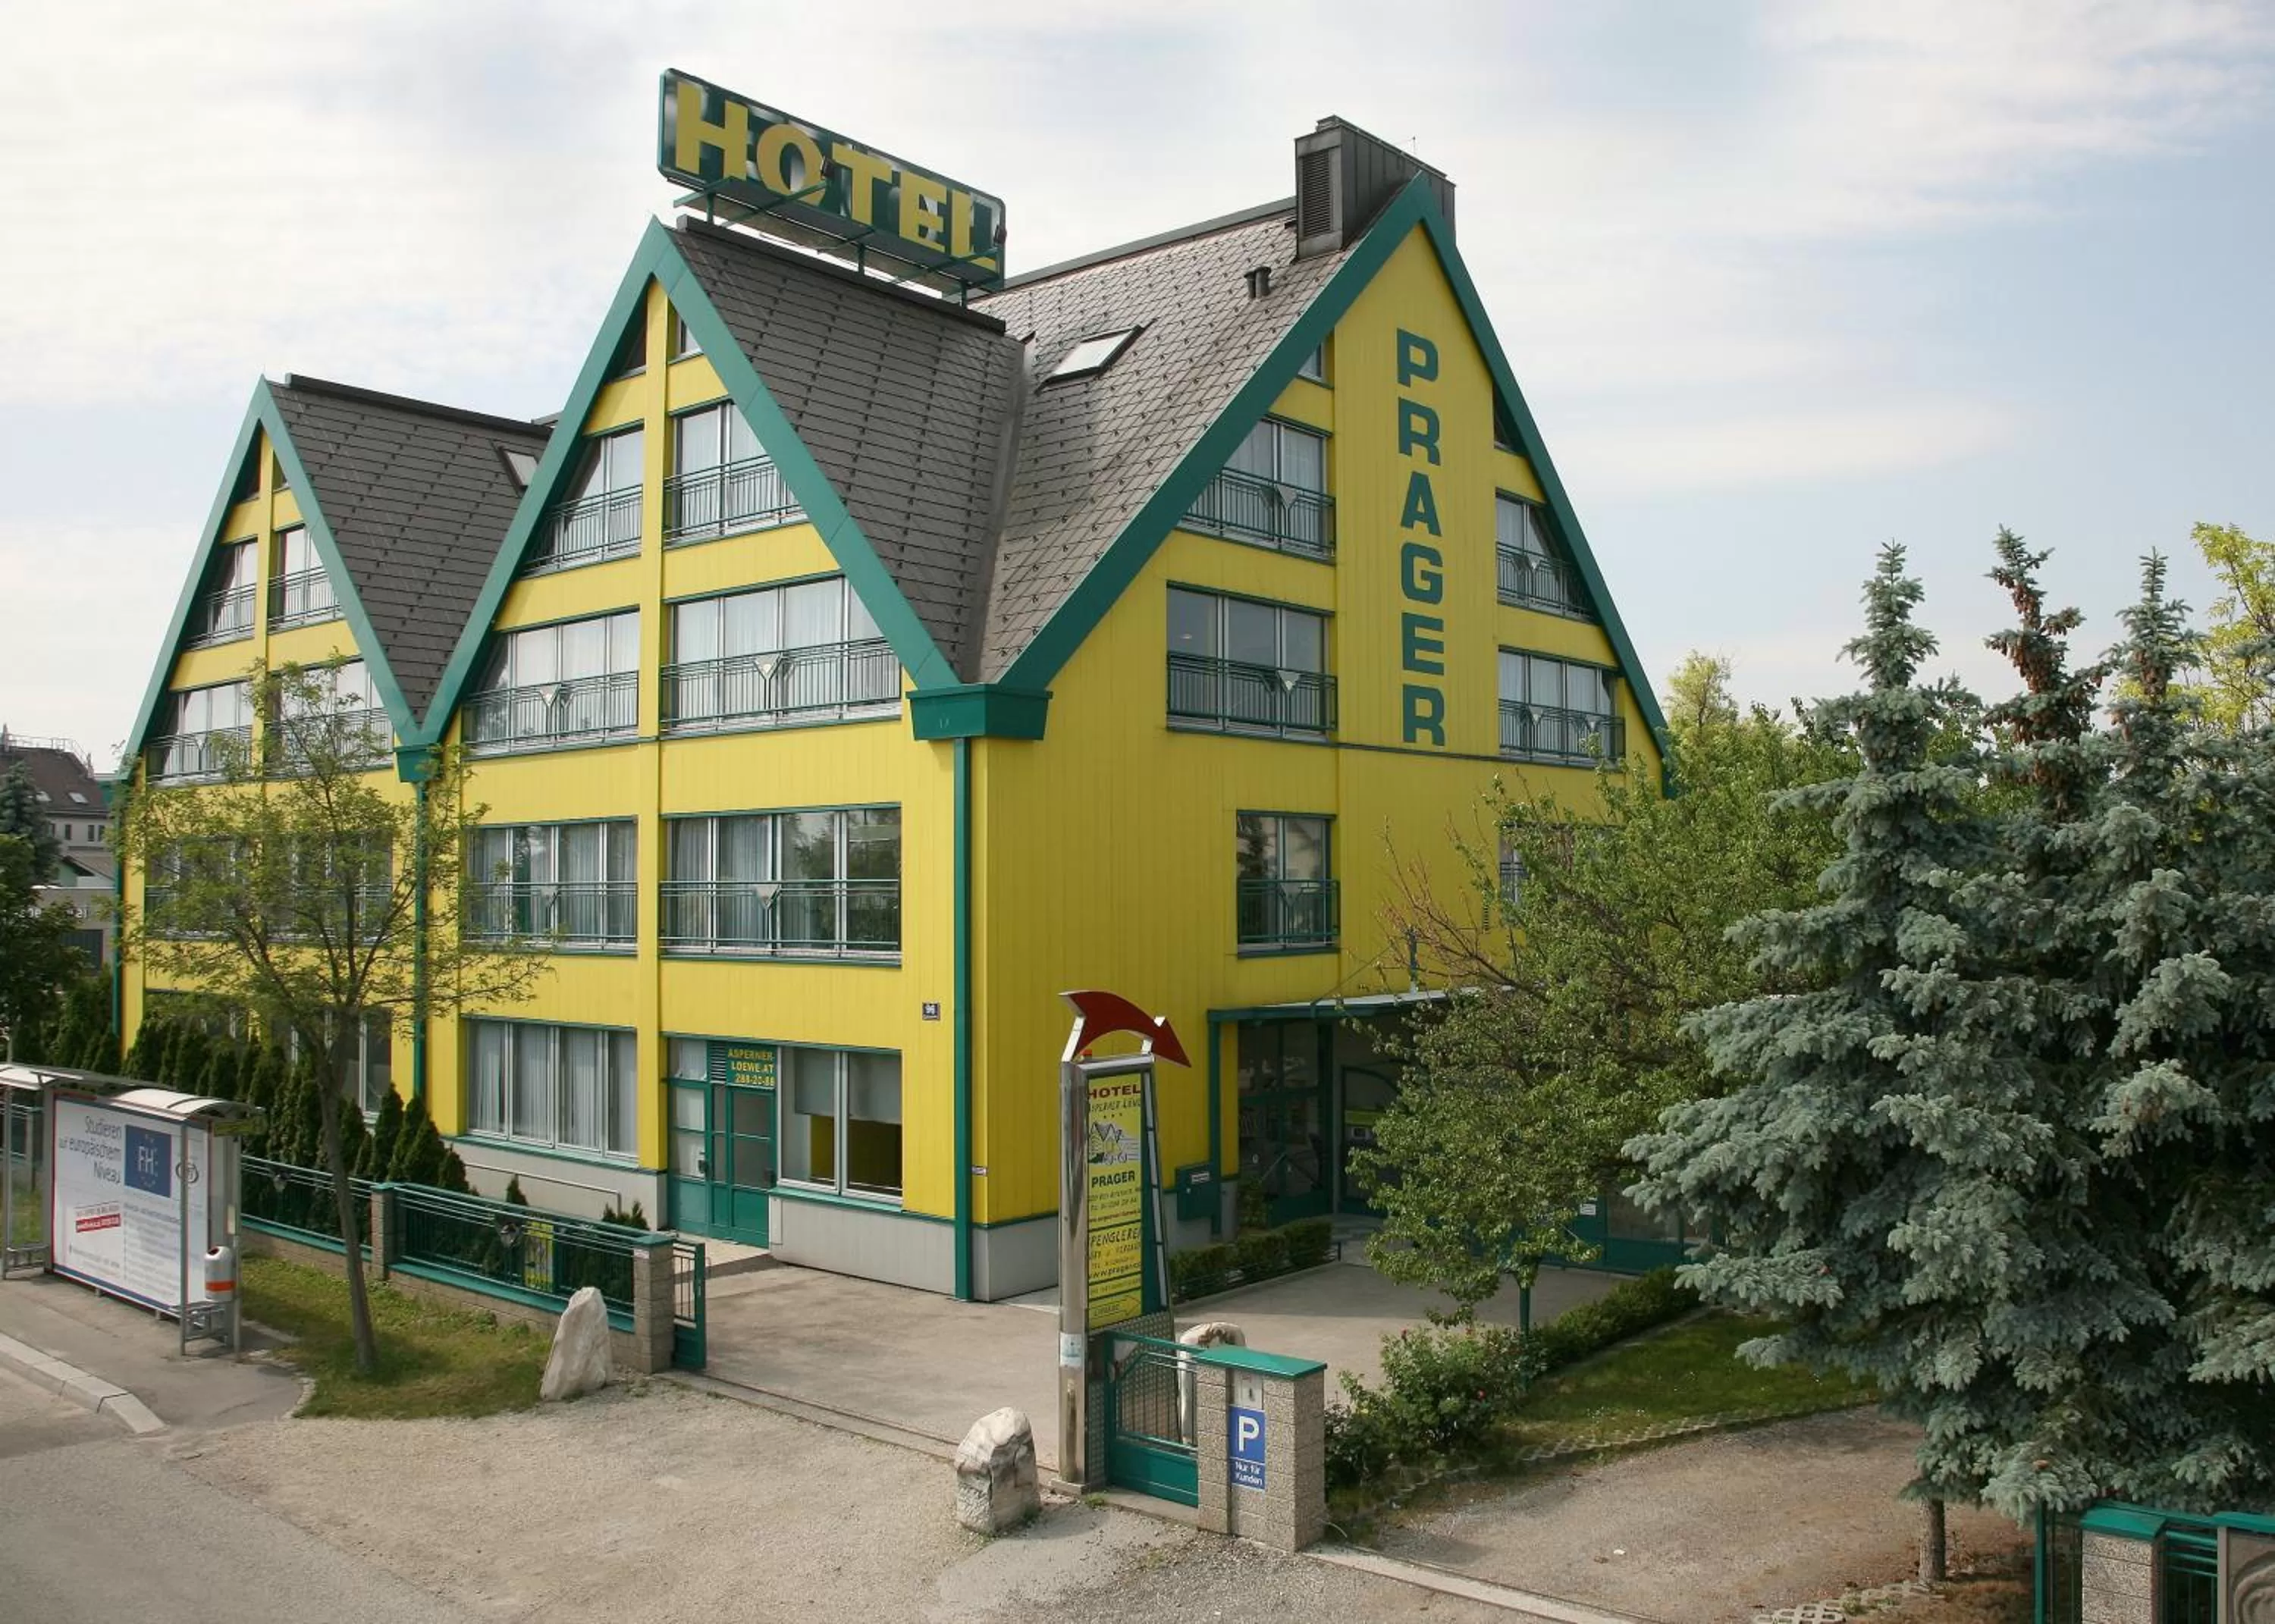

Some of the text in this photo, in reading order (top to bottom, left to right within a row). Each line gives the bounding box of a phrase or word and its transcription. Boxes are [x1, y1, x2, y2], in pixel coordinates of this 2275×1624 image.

[676, 81, 998, 279] HOTEL
[1396, 328, 1445, 747] PRAGER
[1089, 1083, 1141, 1099] HOTEL
[1091, 1170, 1136, 1189] PRAGER
[1238, 1416, 1260, 1452] P
[1235, 1472, 1263, 1486] Kunden
